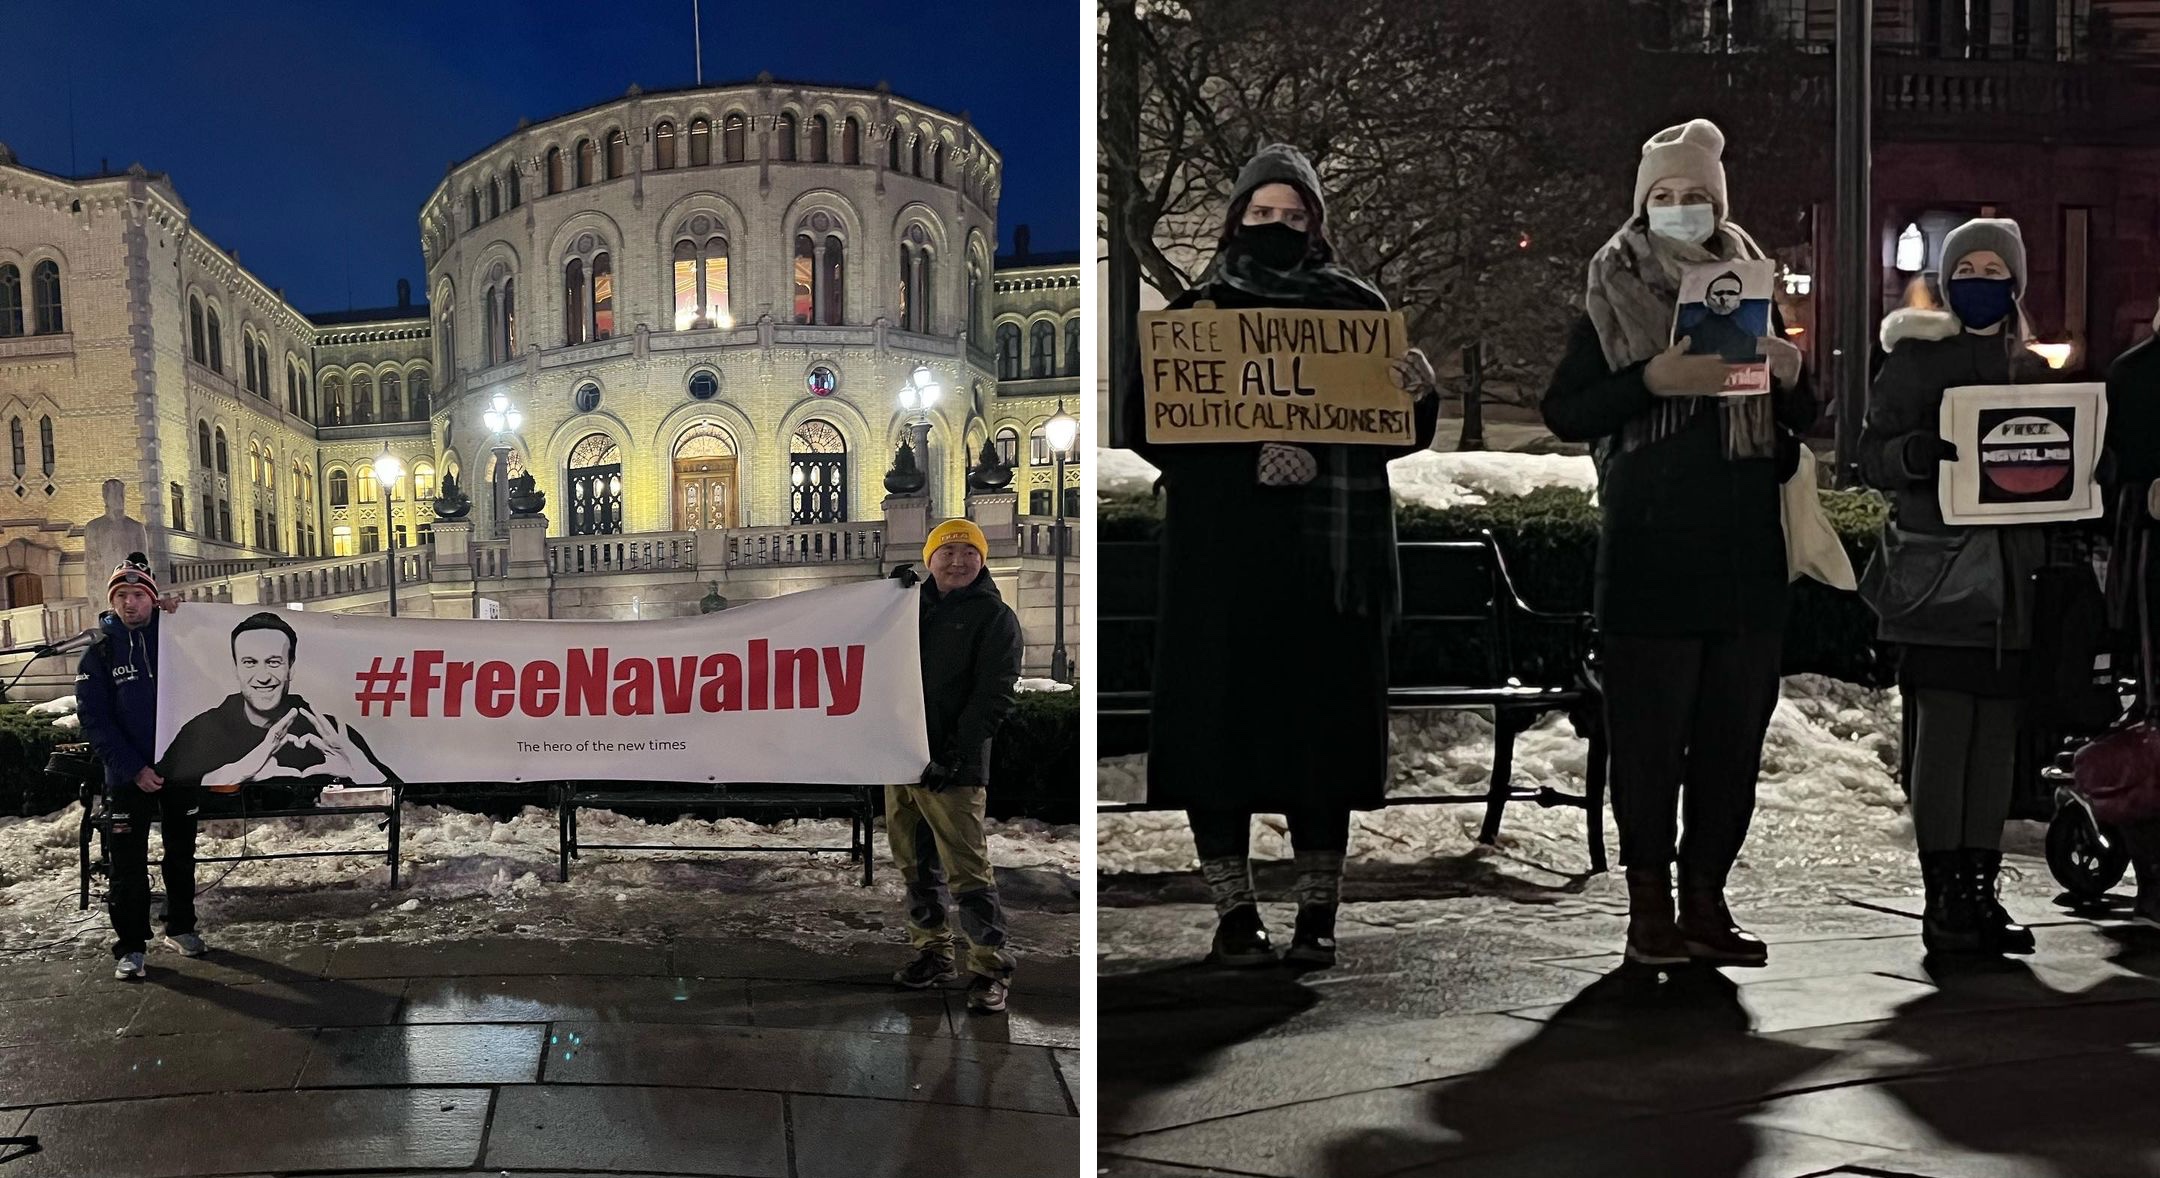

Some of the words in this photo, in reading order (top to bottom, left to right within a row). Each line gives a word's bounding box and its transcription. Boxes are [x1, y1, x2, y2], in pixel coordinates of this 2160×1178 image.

[1151, 321, 1223, 352] FREE
[1153, 359, 1226, 393] FREE
[1242, 357, 1315, 396] ALL
[1155, 398, 1283, 430] POLITICAL
[354, 638, 866, 718] #FreeNavalny
[517, 741, 540, 752] The
[543, 741, 572, 752] hero
[576, 741, 589, 751] of
[592, 741, 614, 751] the
[617, 742, 645, 751] new
[649, 739, 686, 750] times
